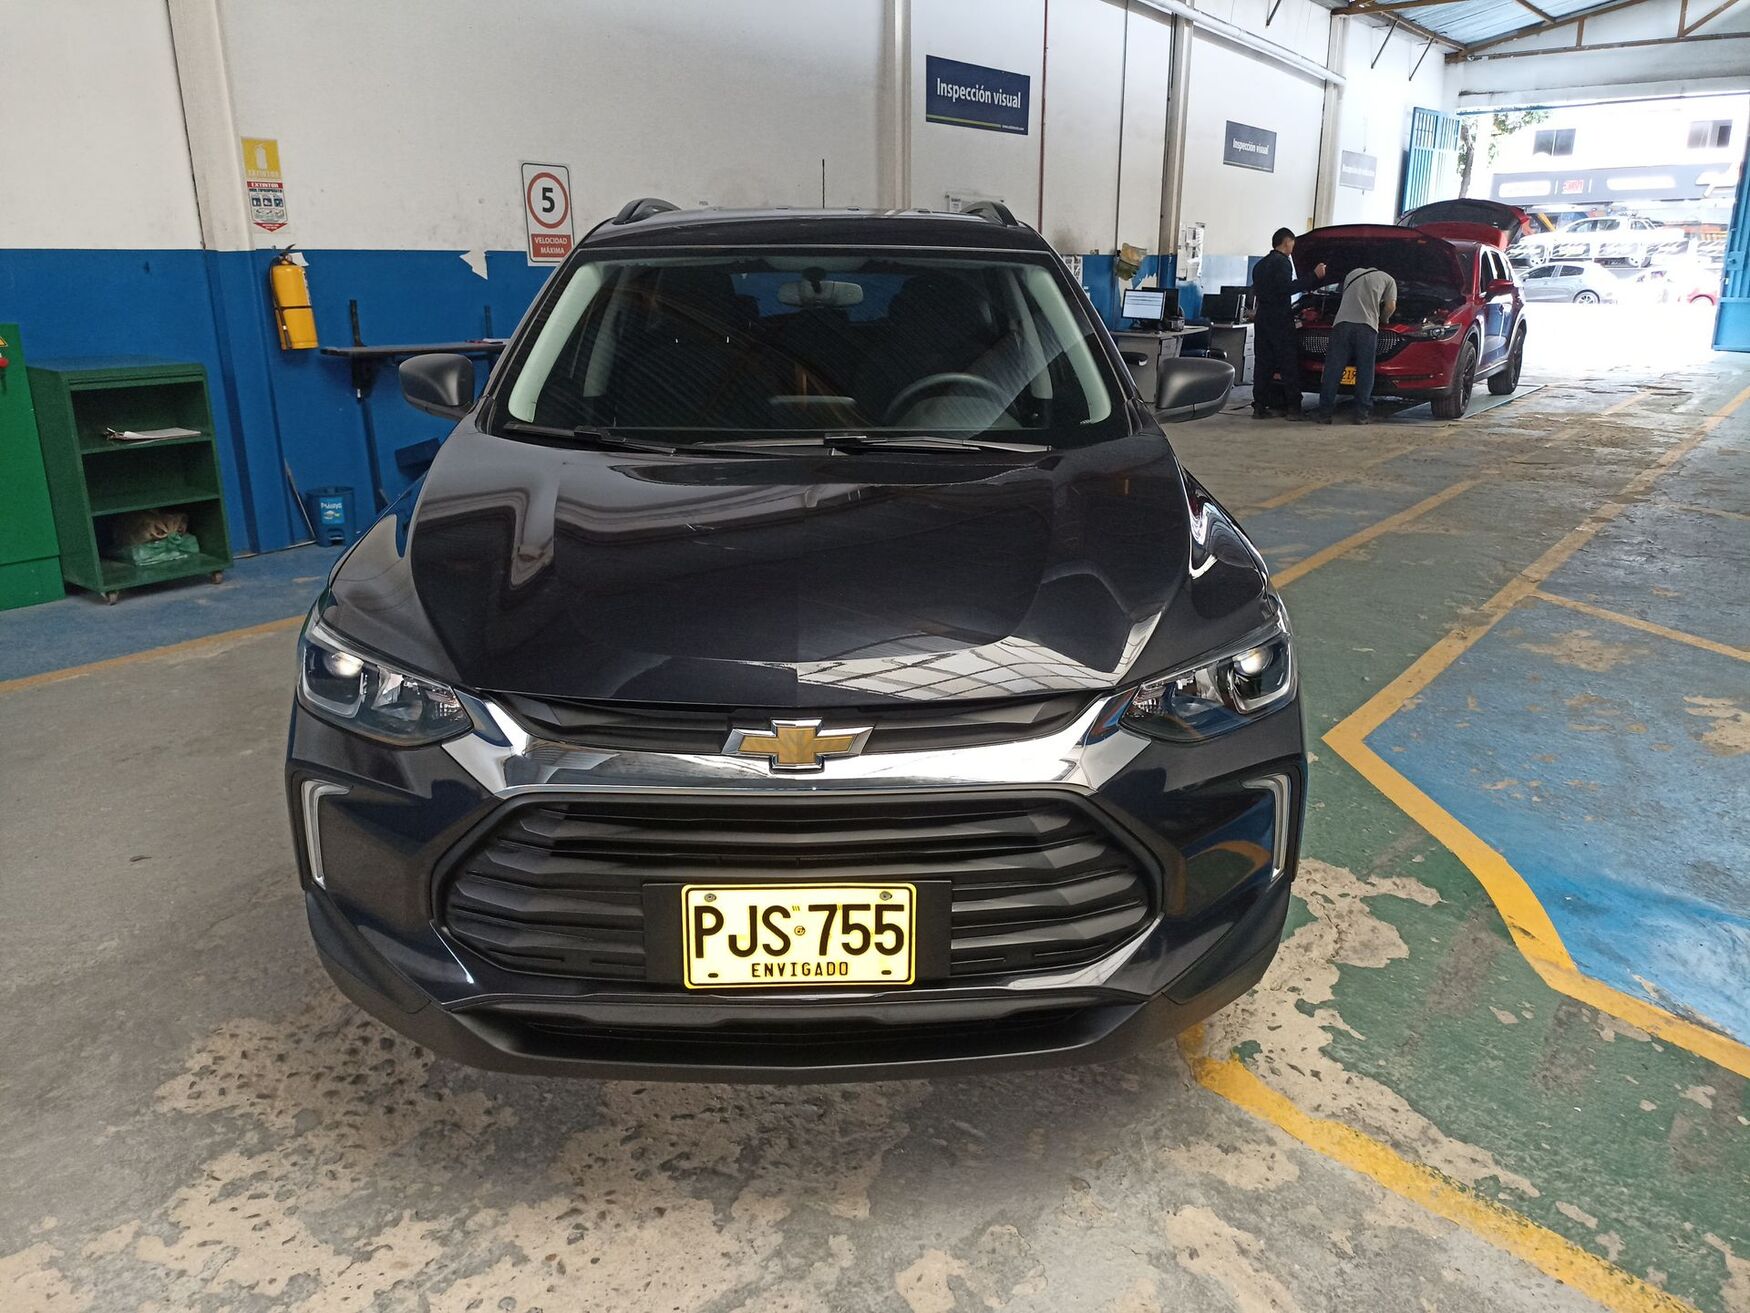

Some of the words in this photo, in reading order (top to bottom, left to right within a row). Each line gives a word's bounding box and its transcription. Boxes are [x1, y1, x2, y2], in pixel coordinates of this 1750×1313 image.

[937, 78, 991, 102] Inspección
[993, 89, 1021, 109] visual
[1233, 138, 1256, 152] Inspección
[1256, 144, 1269, 155] visual
[542, 187, 555, 213] 5
[534, 237, 568, 245] VELOCIDAD
[540, 246, 565, 254] MÁXIMA
[694, 905, 791, 959] PJS
[808, 904, 905, 956] 755
[751, 962, 849, 978] ENVIGADO
